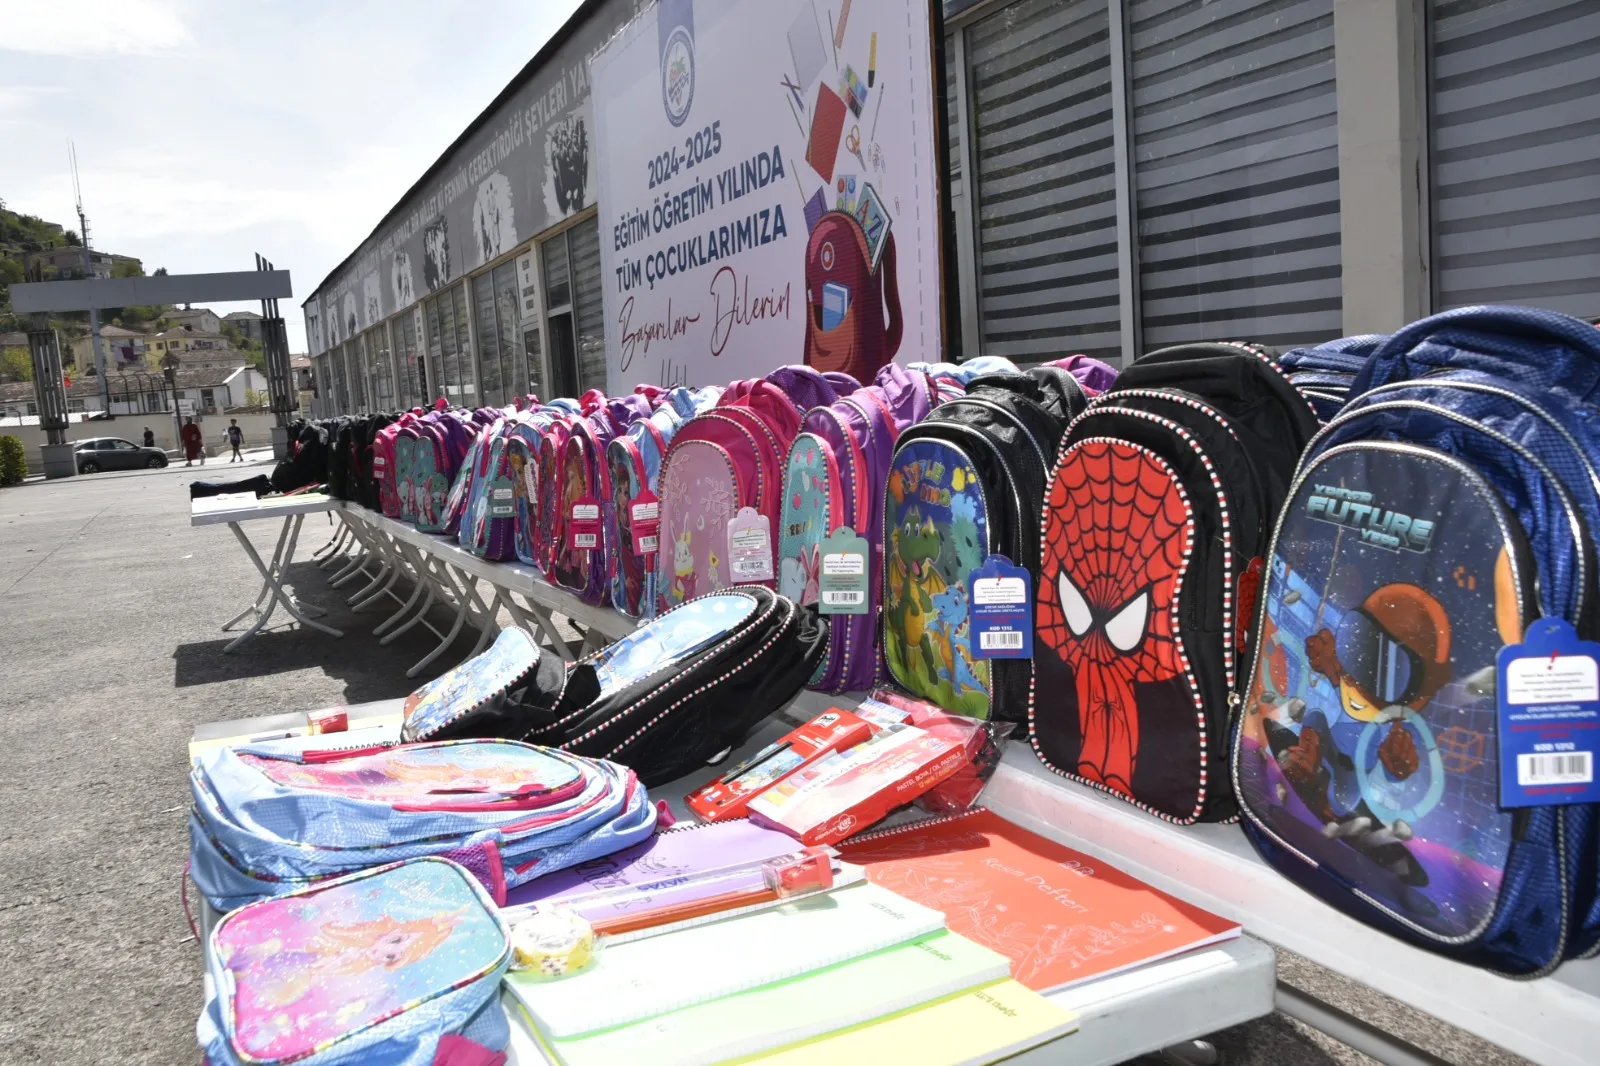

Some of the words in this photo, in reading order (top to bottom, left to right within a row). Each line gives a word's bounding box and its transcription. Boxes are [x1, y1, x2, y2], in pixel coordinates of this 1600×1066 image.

[524, 67, 568, 147] ŞEYLERİ
[647, 119, 722, 190] 2024-2025
[613, 207, 650, 252] EĞİTİM
[652, 176, 714, 233] ÖĞRETİM
[717, 144, 785, 205] YILINDA
[615, 257, 642, 293] TÜM
[645, 203, 788, 290] ÇOCUKLARIMIZA
[1306, 495, 1434, 547] FUTURE
[896, 778, 916, 792] PASTEL
[1023, 874, 1090, 914] Defteri
